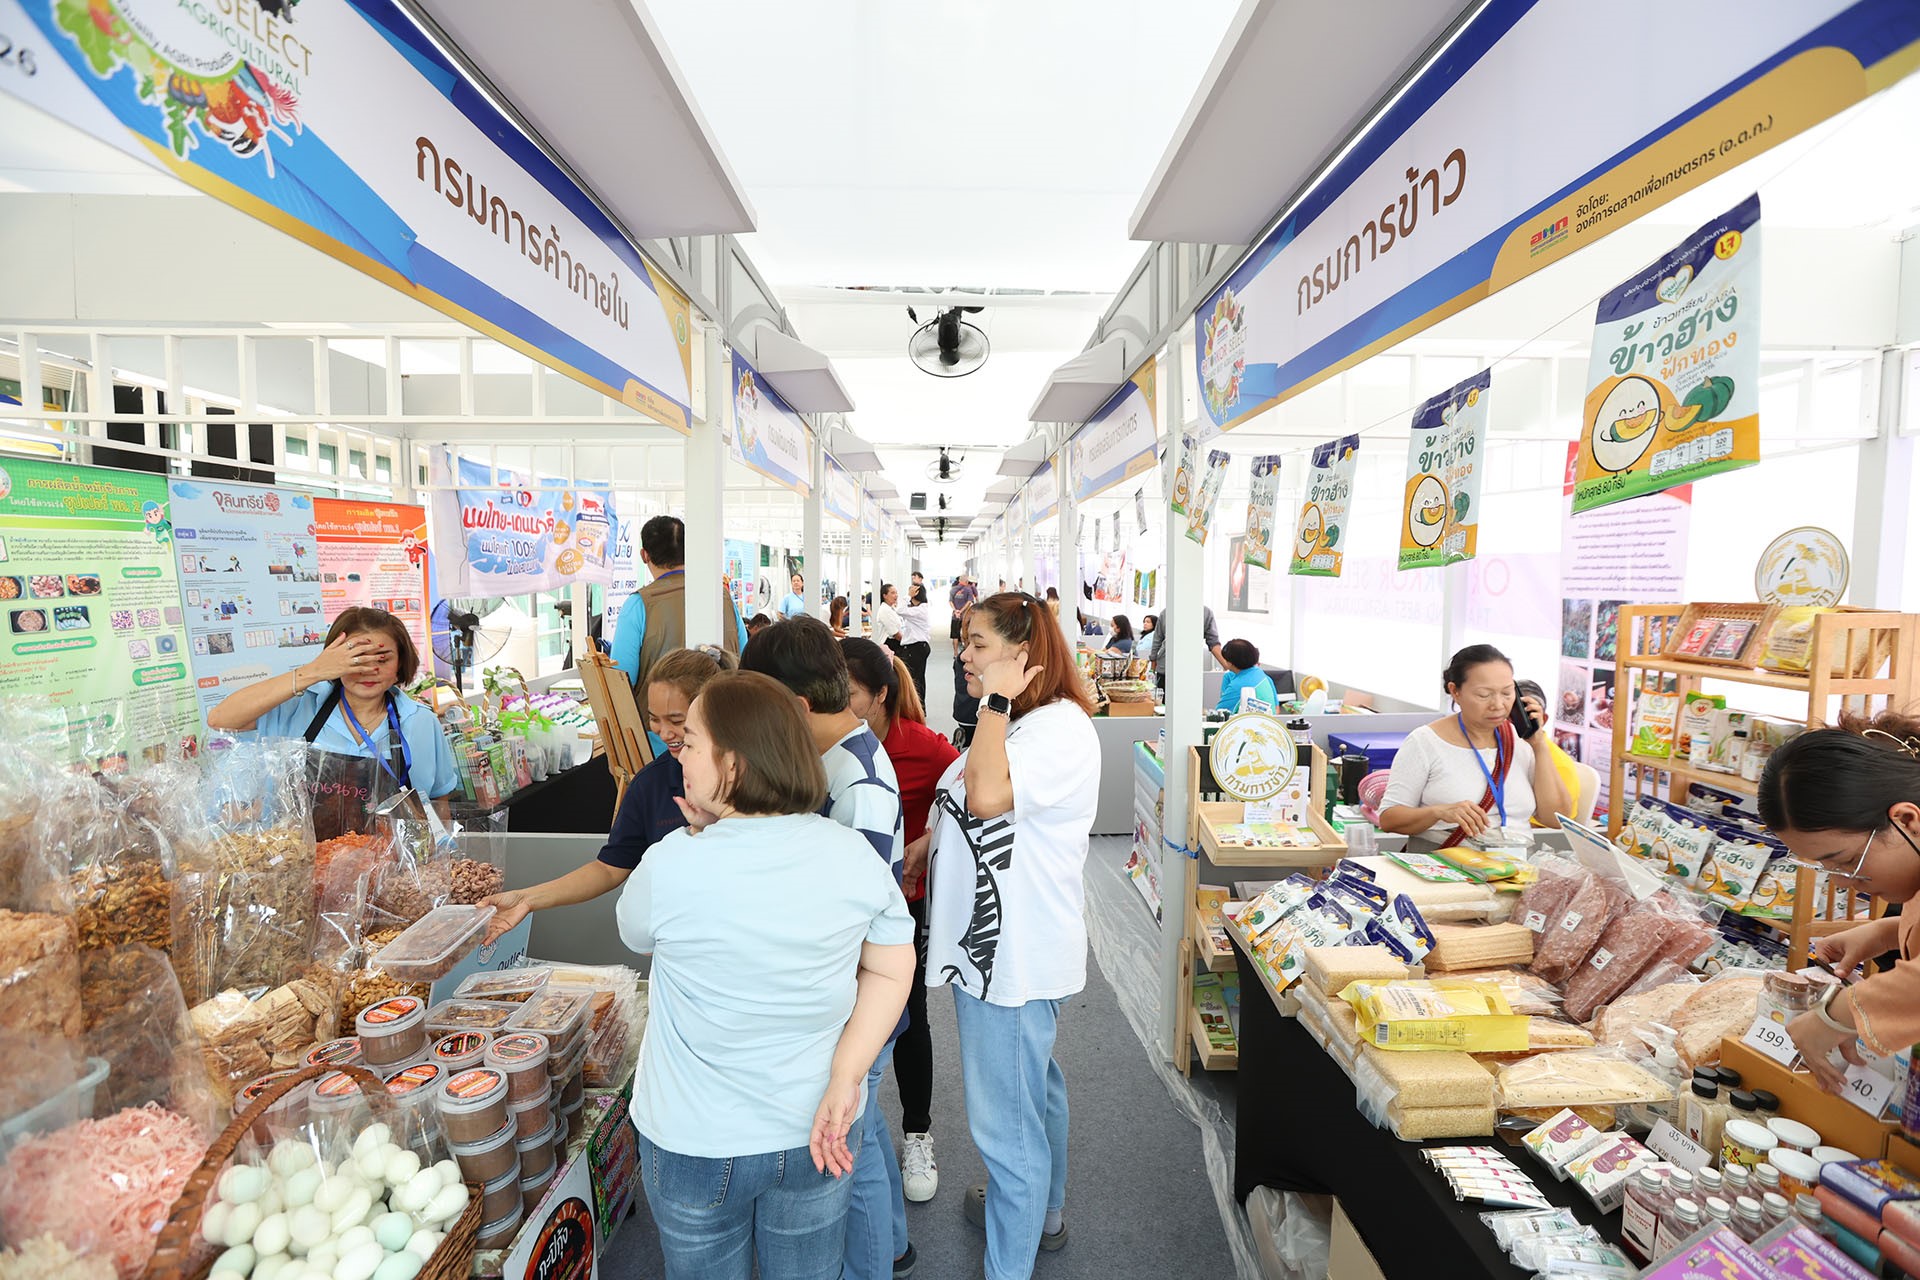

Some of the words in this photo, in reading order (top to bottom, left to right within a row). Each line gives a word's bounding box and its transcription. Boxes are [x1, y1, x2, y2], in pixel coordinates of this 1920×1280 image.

[176, 0, 301, 96] AGRICULTURAL
[216, 0, 313, 77] SELECT
[1576, 147, 1715, 233] องค์การตลาดเพื่อเกษตรกร
[1719, 114, 1774, 156] (อ.ต.ก.)
[1576, 193, 1609, 219] จัดโดย:
[415, 136, 629, 331] กรมการค้าภายใน
[1296, 148, 1467, 316] กรมการข้าว
[1653, 292, 1708, 329] ข้าวเกรียบ
[1609, 294, 1739, 375] ข้าวฮาง
[1660, 331, 1739, 381] ฟักทอง
[212, 491, 264, 512] จุลินทรีย์
[1223, 765, 1290, 795] กรมการข้าว
[1755, 1026, 1790, 1051] 199.-
[1851, 1078, 1878, 1102] 40.-
[1670, 1156, 1681, 1168] 100
[1682, 1139, 1697, 1155] บาท
[539, 1226, 569, 1280] กะปิกุ้ง
